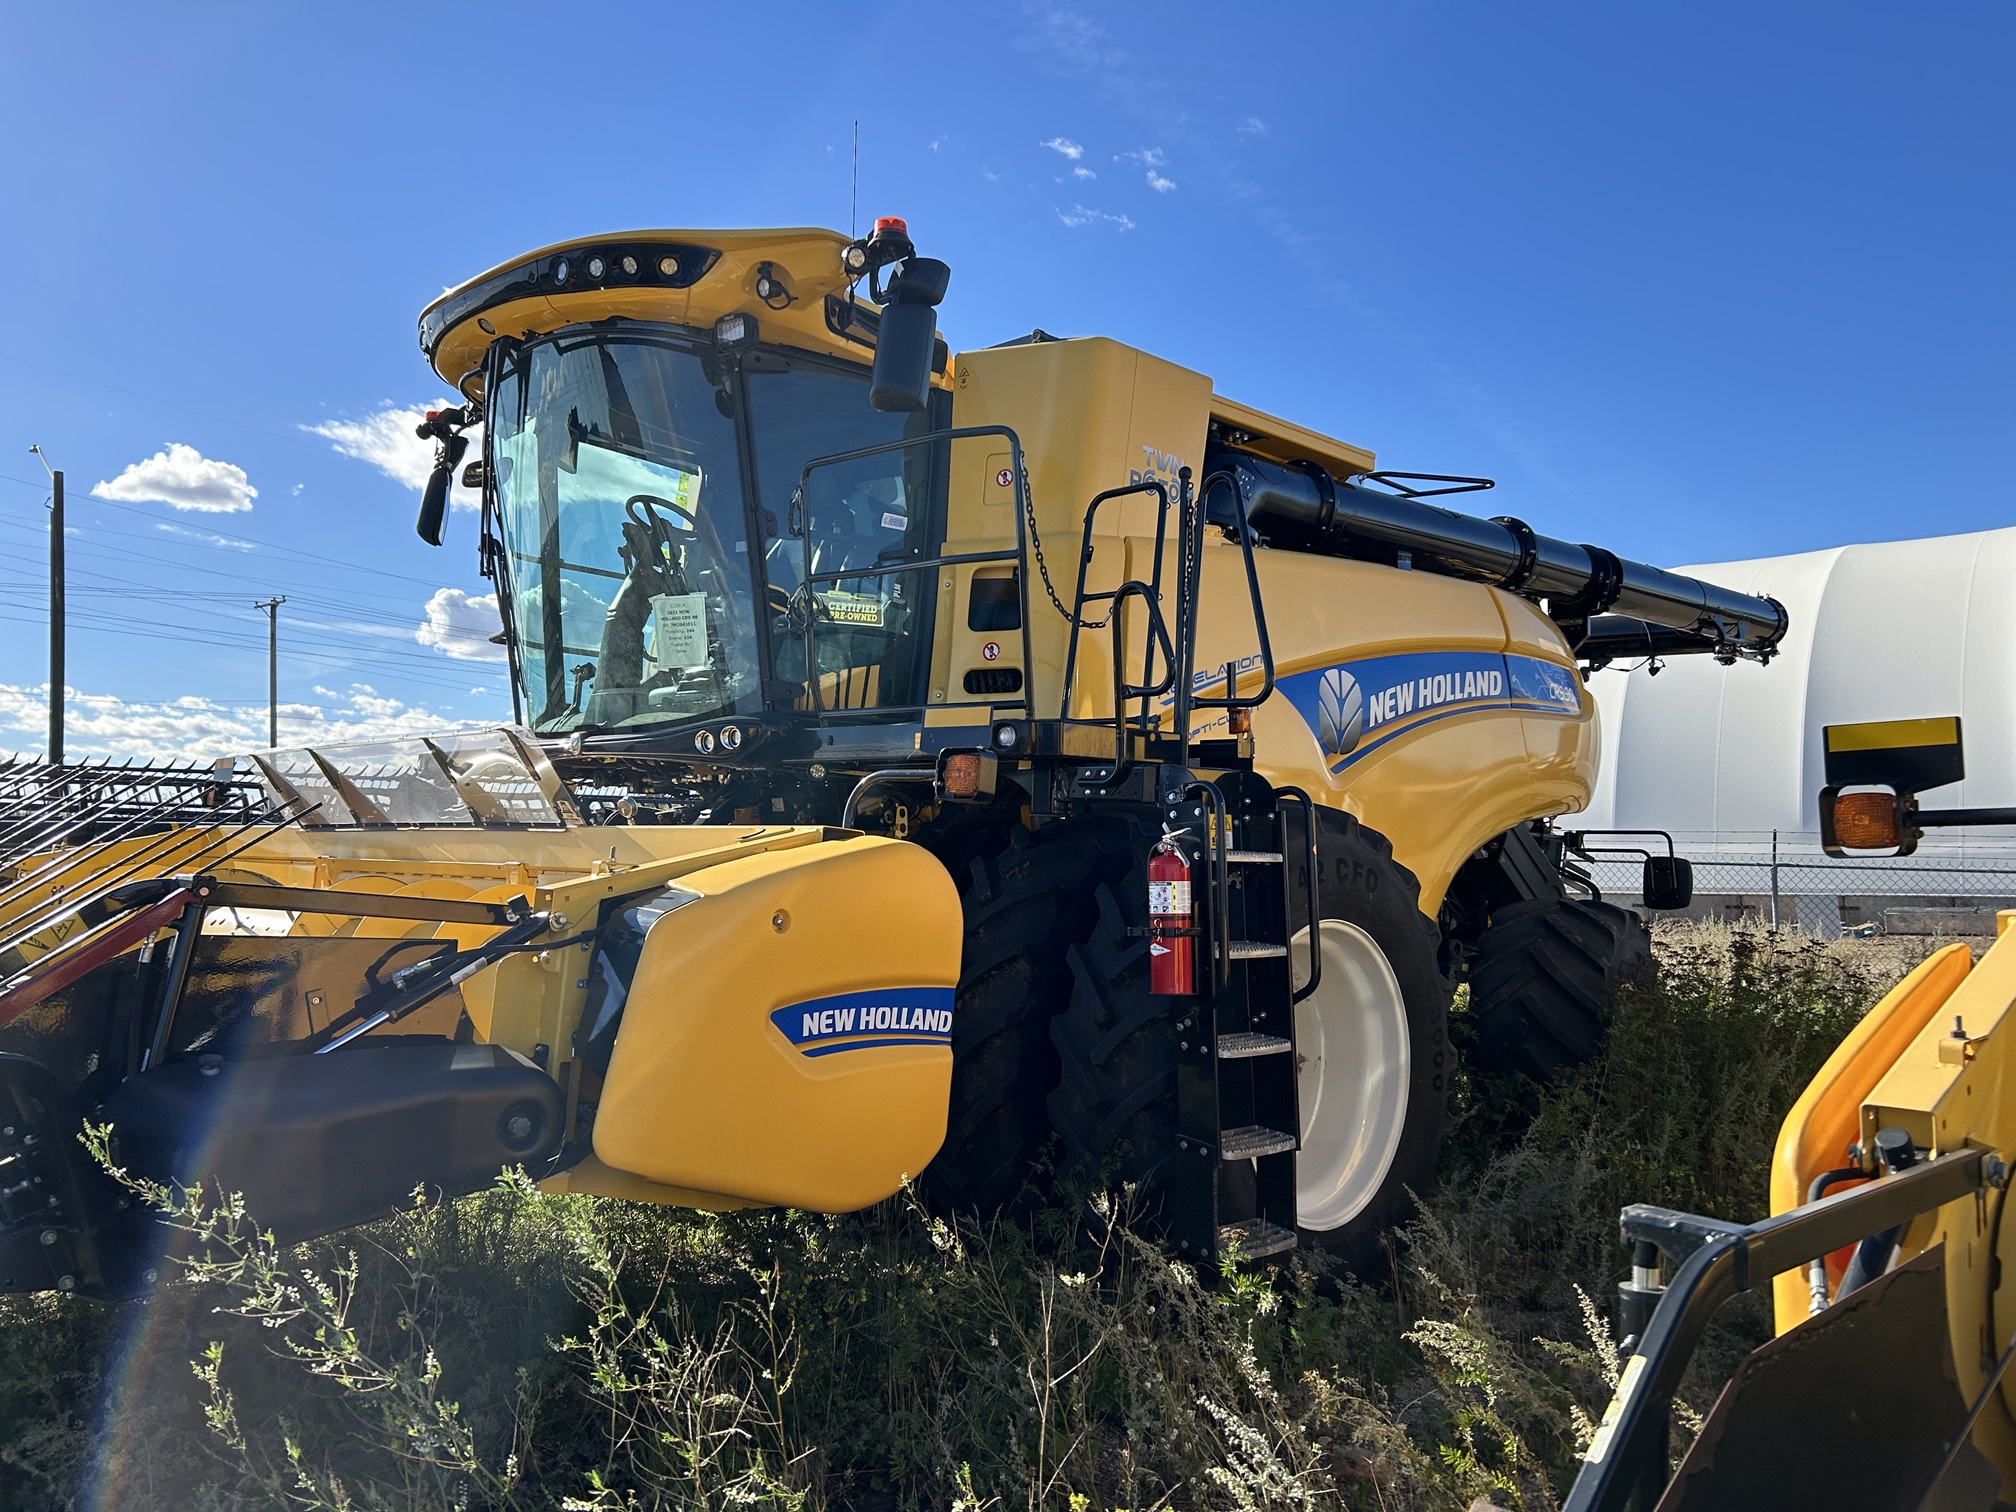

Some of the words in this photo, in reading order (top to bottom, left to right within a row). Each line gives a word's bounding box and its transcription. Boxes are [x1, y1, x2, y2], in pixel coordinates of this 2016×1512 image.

[1130, 469, 1193, 504] ROTO
[828, 602, 877, 614] CERTIFIED
[829, 611, 878, 622] PRE-OWNED
[1369, 681, 1415, 728] NEW
[1418, 670, 1502, 709] HOLLAND
[802, 1008, 856, 1037] NEW
[859, 1006, 953, 1033] HOLLAND
